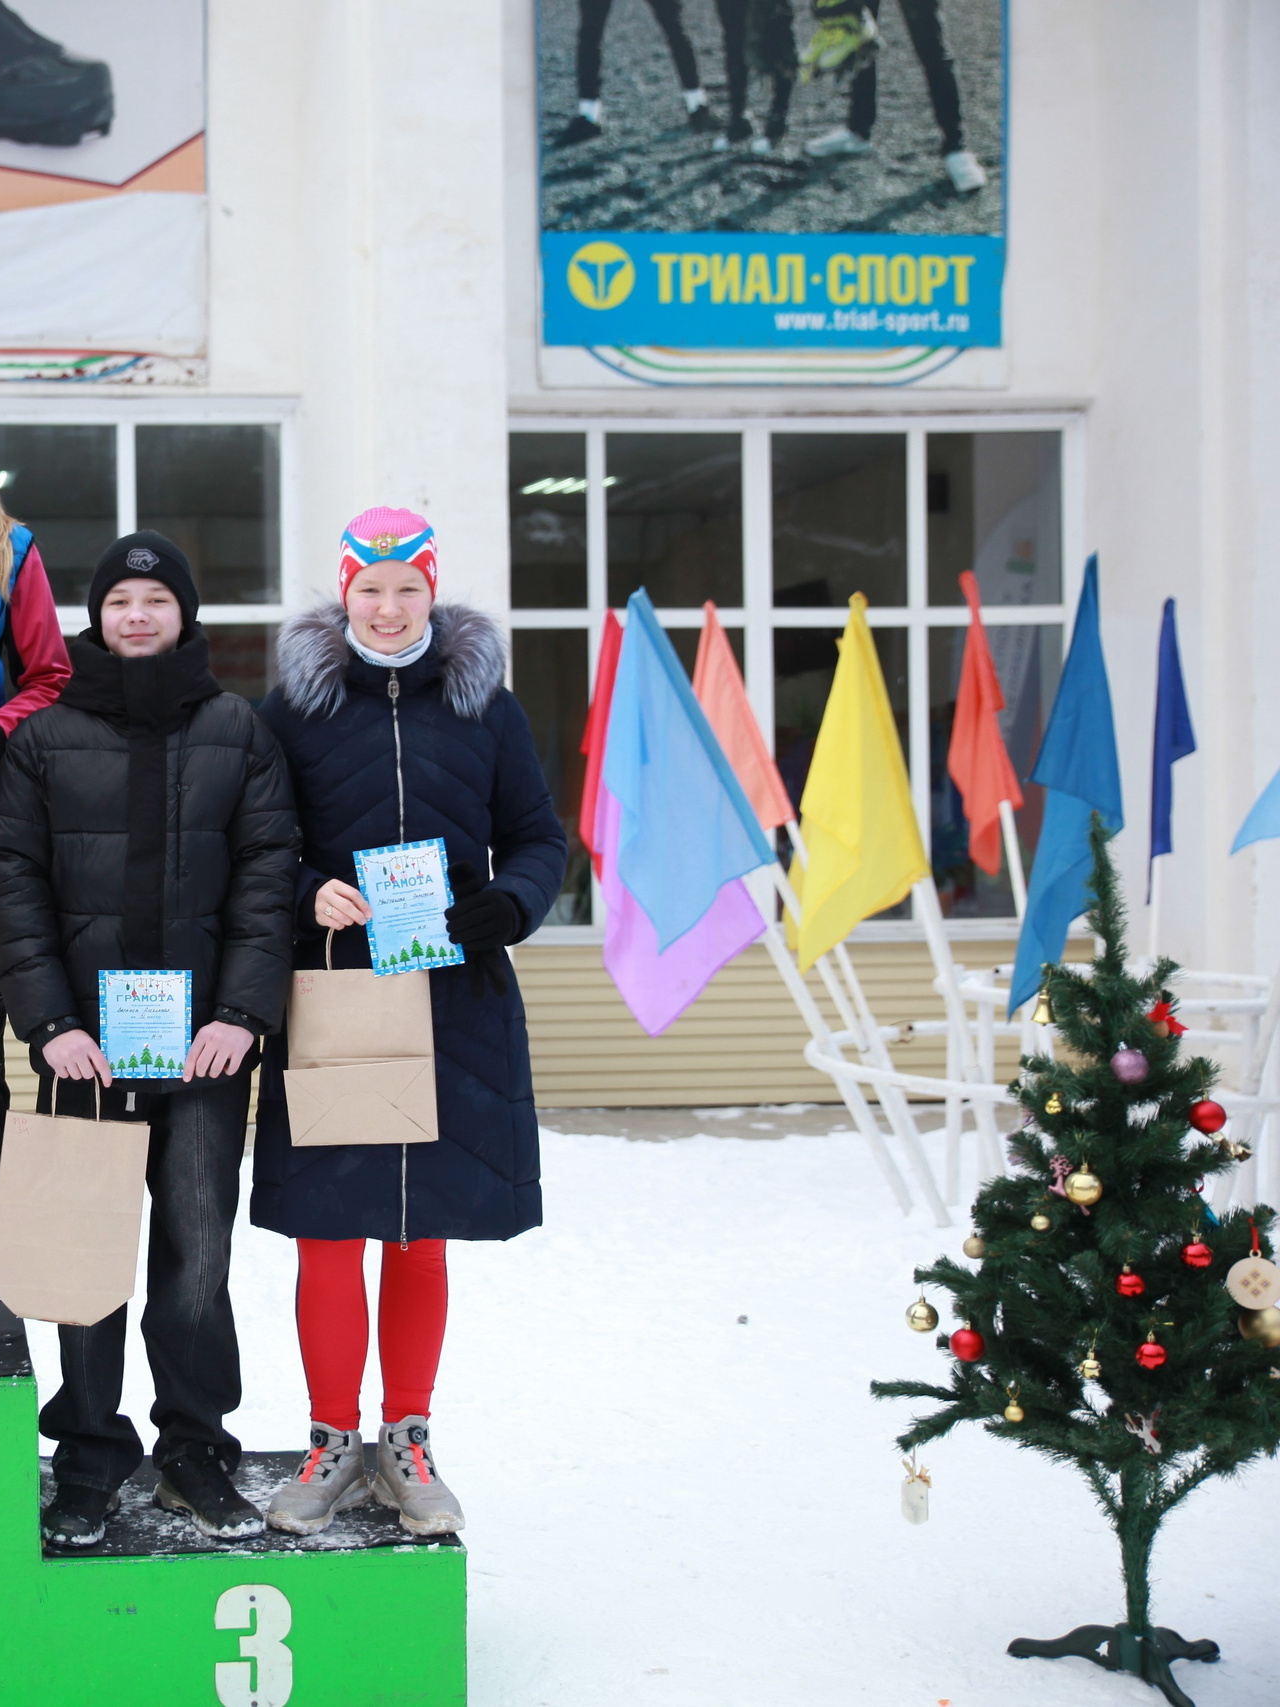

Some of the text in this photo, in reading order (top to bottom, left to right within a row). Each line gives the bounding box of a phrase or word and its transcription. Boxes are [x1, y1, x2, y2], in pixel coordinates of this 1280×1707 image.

[774, 308, 969, 335] www.trial-sport.ru
[376, 874, 433, 892] ГРАМОТА
[116, 994, 175, 1002] ГРАМОТА
[214, 1585, 293, 1707] 3
